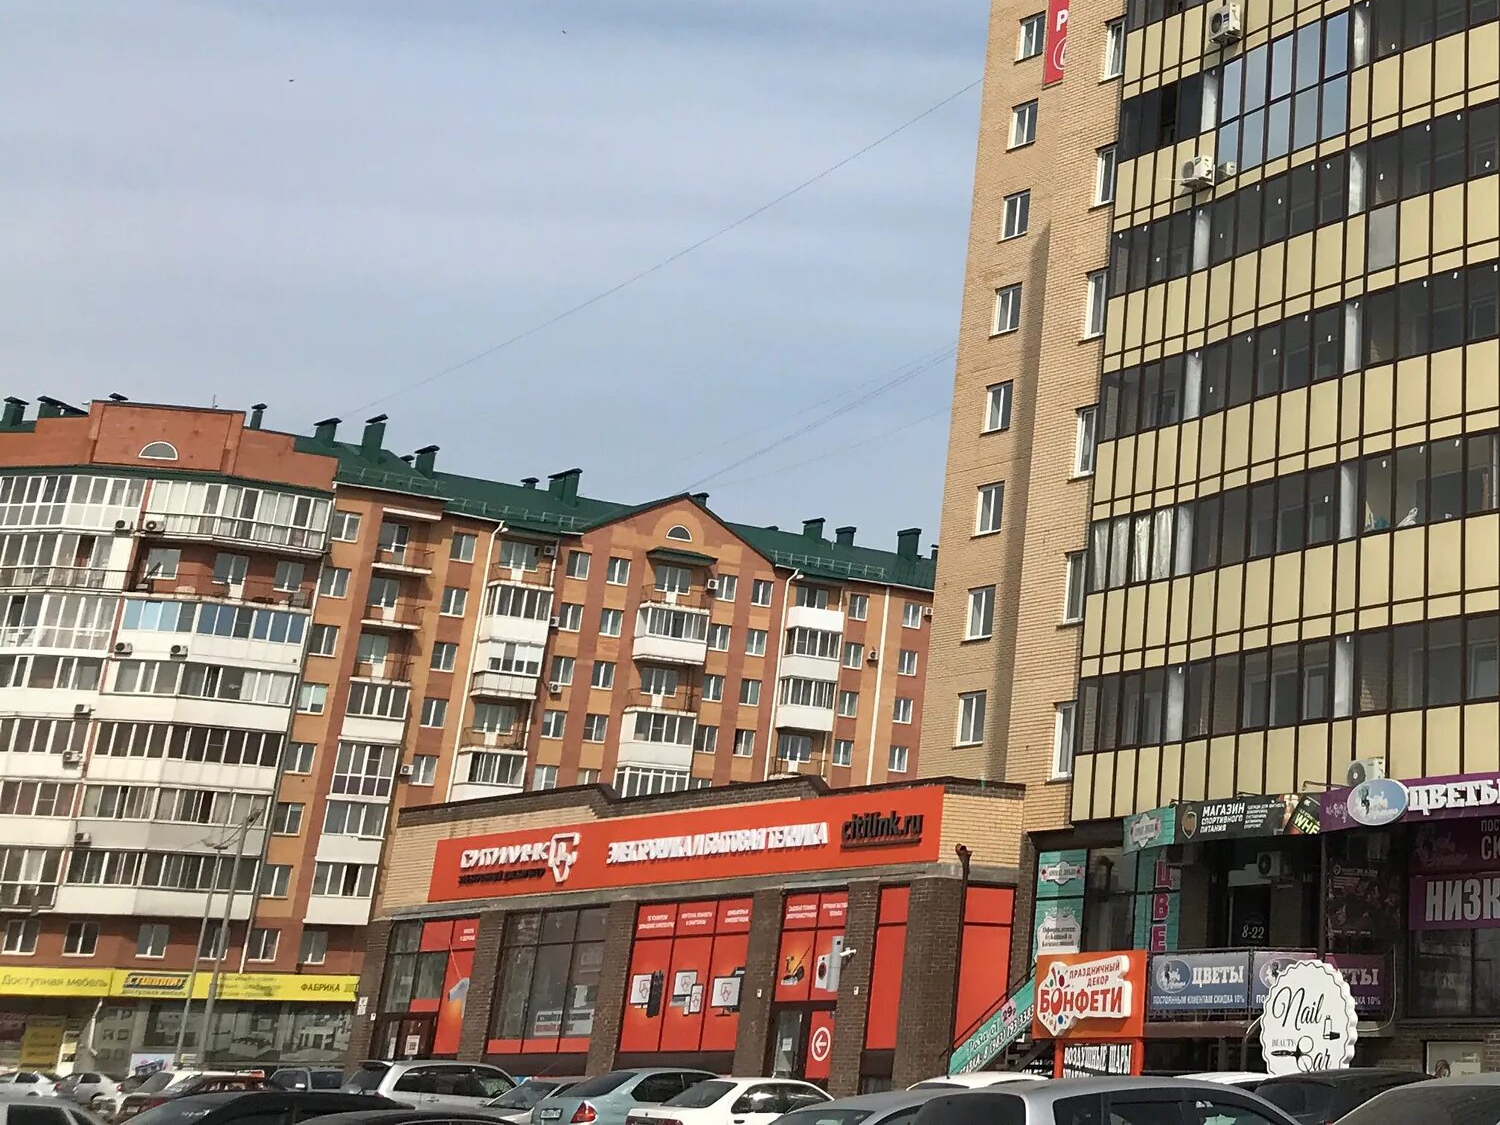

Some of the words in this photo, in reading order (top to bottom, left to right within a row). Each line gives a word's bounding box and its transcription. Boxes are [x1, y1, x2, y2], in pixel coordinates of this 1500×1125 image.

[1202, 802, 1246, 817] МАГАЗИН
[1201, 815, 1244, 826] СПОРТИВНОГО
[1200, 825, 1227, 834] ПИТАНИЯ
[1069, 959, 1120, 979] ПРАЗДНИЧНЫЙ
[1192, 965, 1244, 988] ЦВЕТЫ
[300, 983, 340, 992] ФАБРИКА
[1087, 975, 1109, 988] ДЕКОР
[1039, 987, 1122, 1015] БОНФЕТИ
[1272, 987, 1324, 1030] Nail
